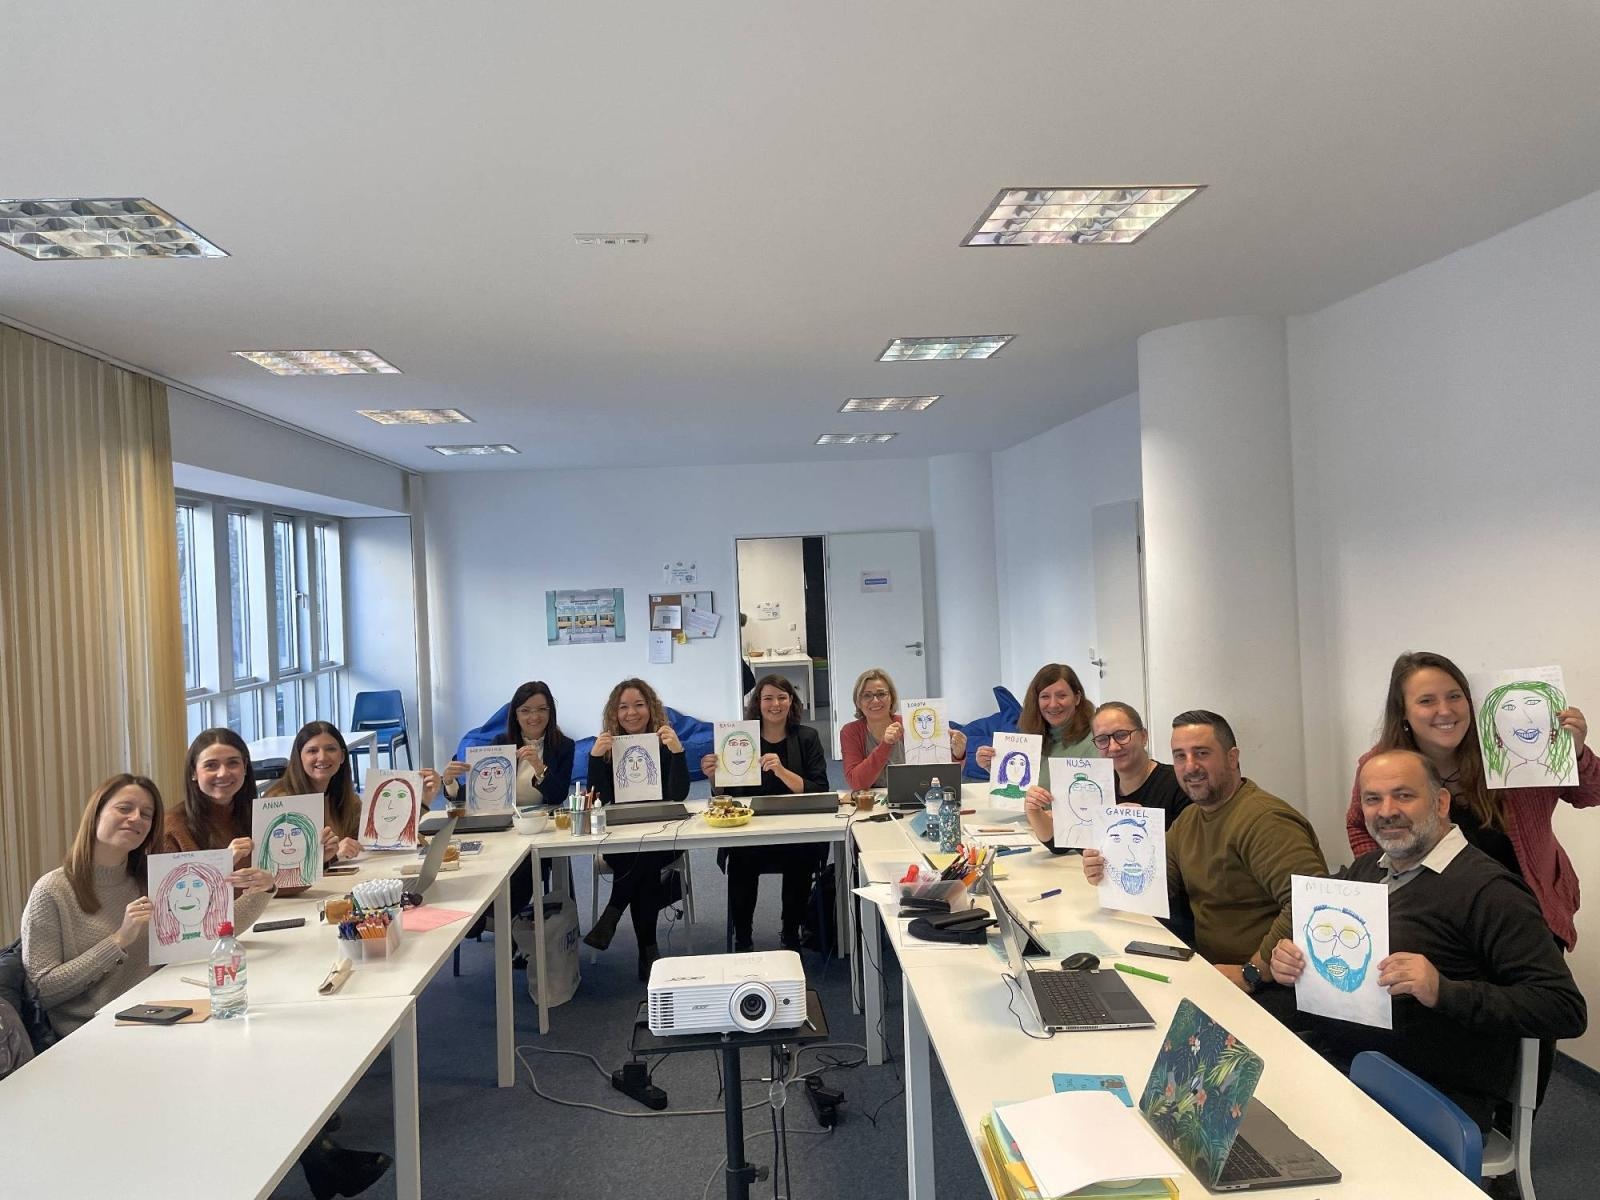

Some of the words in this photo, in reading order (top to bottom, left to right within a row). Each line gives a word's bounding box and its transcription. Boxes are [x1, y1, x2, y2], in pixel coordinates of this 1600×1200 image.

[1004, 735, 1029, 744] MOJCA
[262, 801, 284, 810] ANNA
[1105, 807, 1150, 819] GAVRIEL
[1305, 880, 1361, 897] MILTOS
